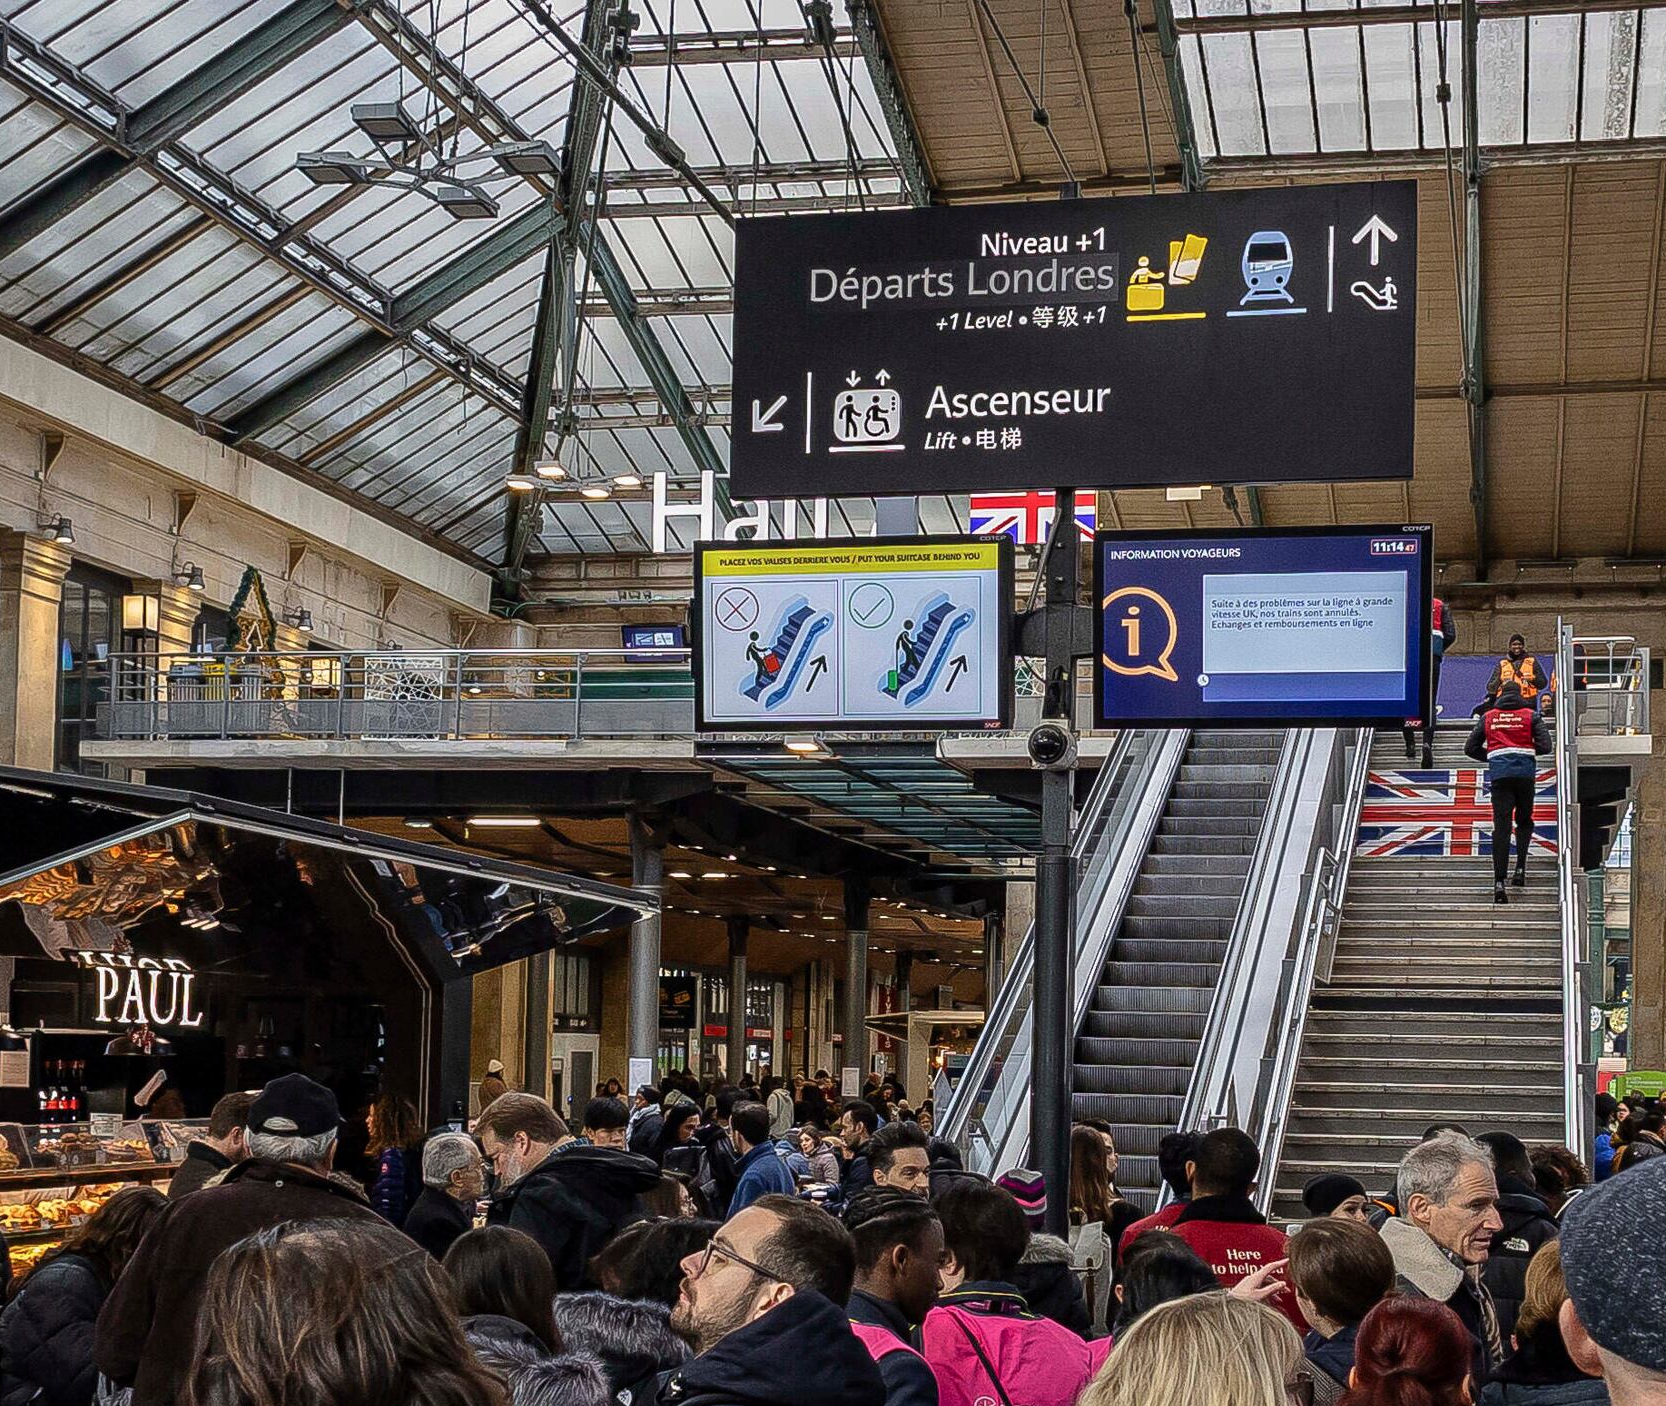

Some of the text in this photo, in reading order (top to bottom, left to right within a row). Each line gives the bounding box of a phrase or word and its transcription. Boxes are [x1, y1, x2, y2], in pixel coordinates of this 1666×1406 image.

[980, 227, 1107, 257] Niveau +1
[809, 258, 1115, 309] Départs Londres
[936, 306, 1108, 332] +1 Level 等级 +1
[924, 382, 1112, 420] Ascenseur
[924, 427, 1023, 452] Lift 电梯
[1111, 548, 1241, 561] INFORMATION VOYAGEURS
[1373, 541, 1405, 553] 11:14
[747, 558, 762, 566] VOS
[764, 557, 792, 566] VALISES
[830, 555, 851, 564] VOUS
[858, 555, 873, 563] PUT
[874, 554, 895, 563] YOUR
[897, 553, 931, 562] SUITCASE
[933, 552, 962, 561] BEHIND
[963, 551, 980, 560] YOU
[1211, 599, 1234, 609] Suite
[1243, 598, 1258, 608] des
[1260, 597, 1305, 611] problèmes
[1307, 600, 1321, 608] sur
[1322, 597, 1330, 607] la
[1332, 597, 1353, 610] ligne
[1363, 596, 1393, 609] grande
[1211, 607, 1362, 620] vitesse UK, nos trains sont annulés.
[1211, 617, 1374, 631] Echanges et remboursements en ligne
[95, 966, 204, 1026] PAUL
[1226, 1248, 1262, 1260] Here
[1211, 1264, 1227, 1275] to
[1229, 1262, 1259, 1276] help
